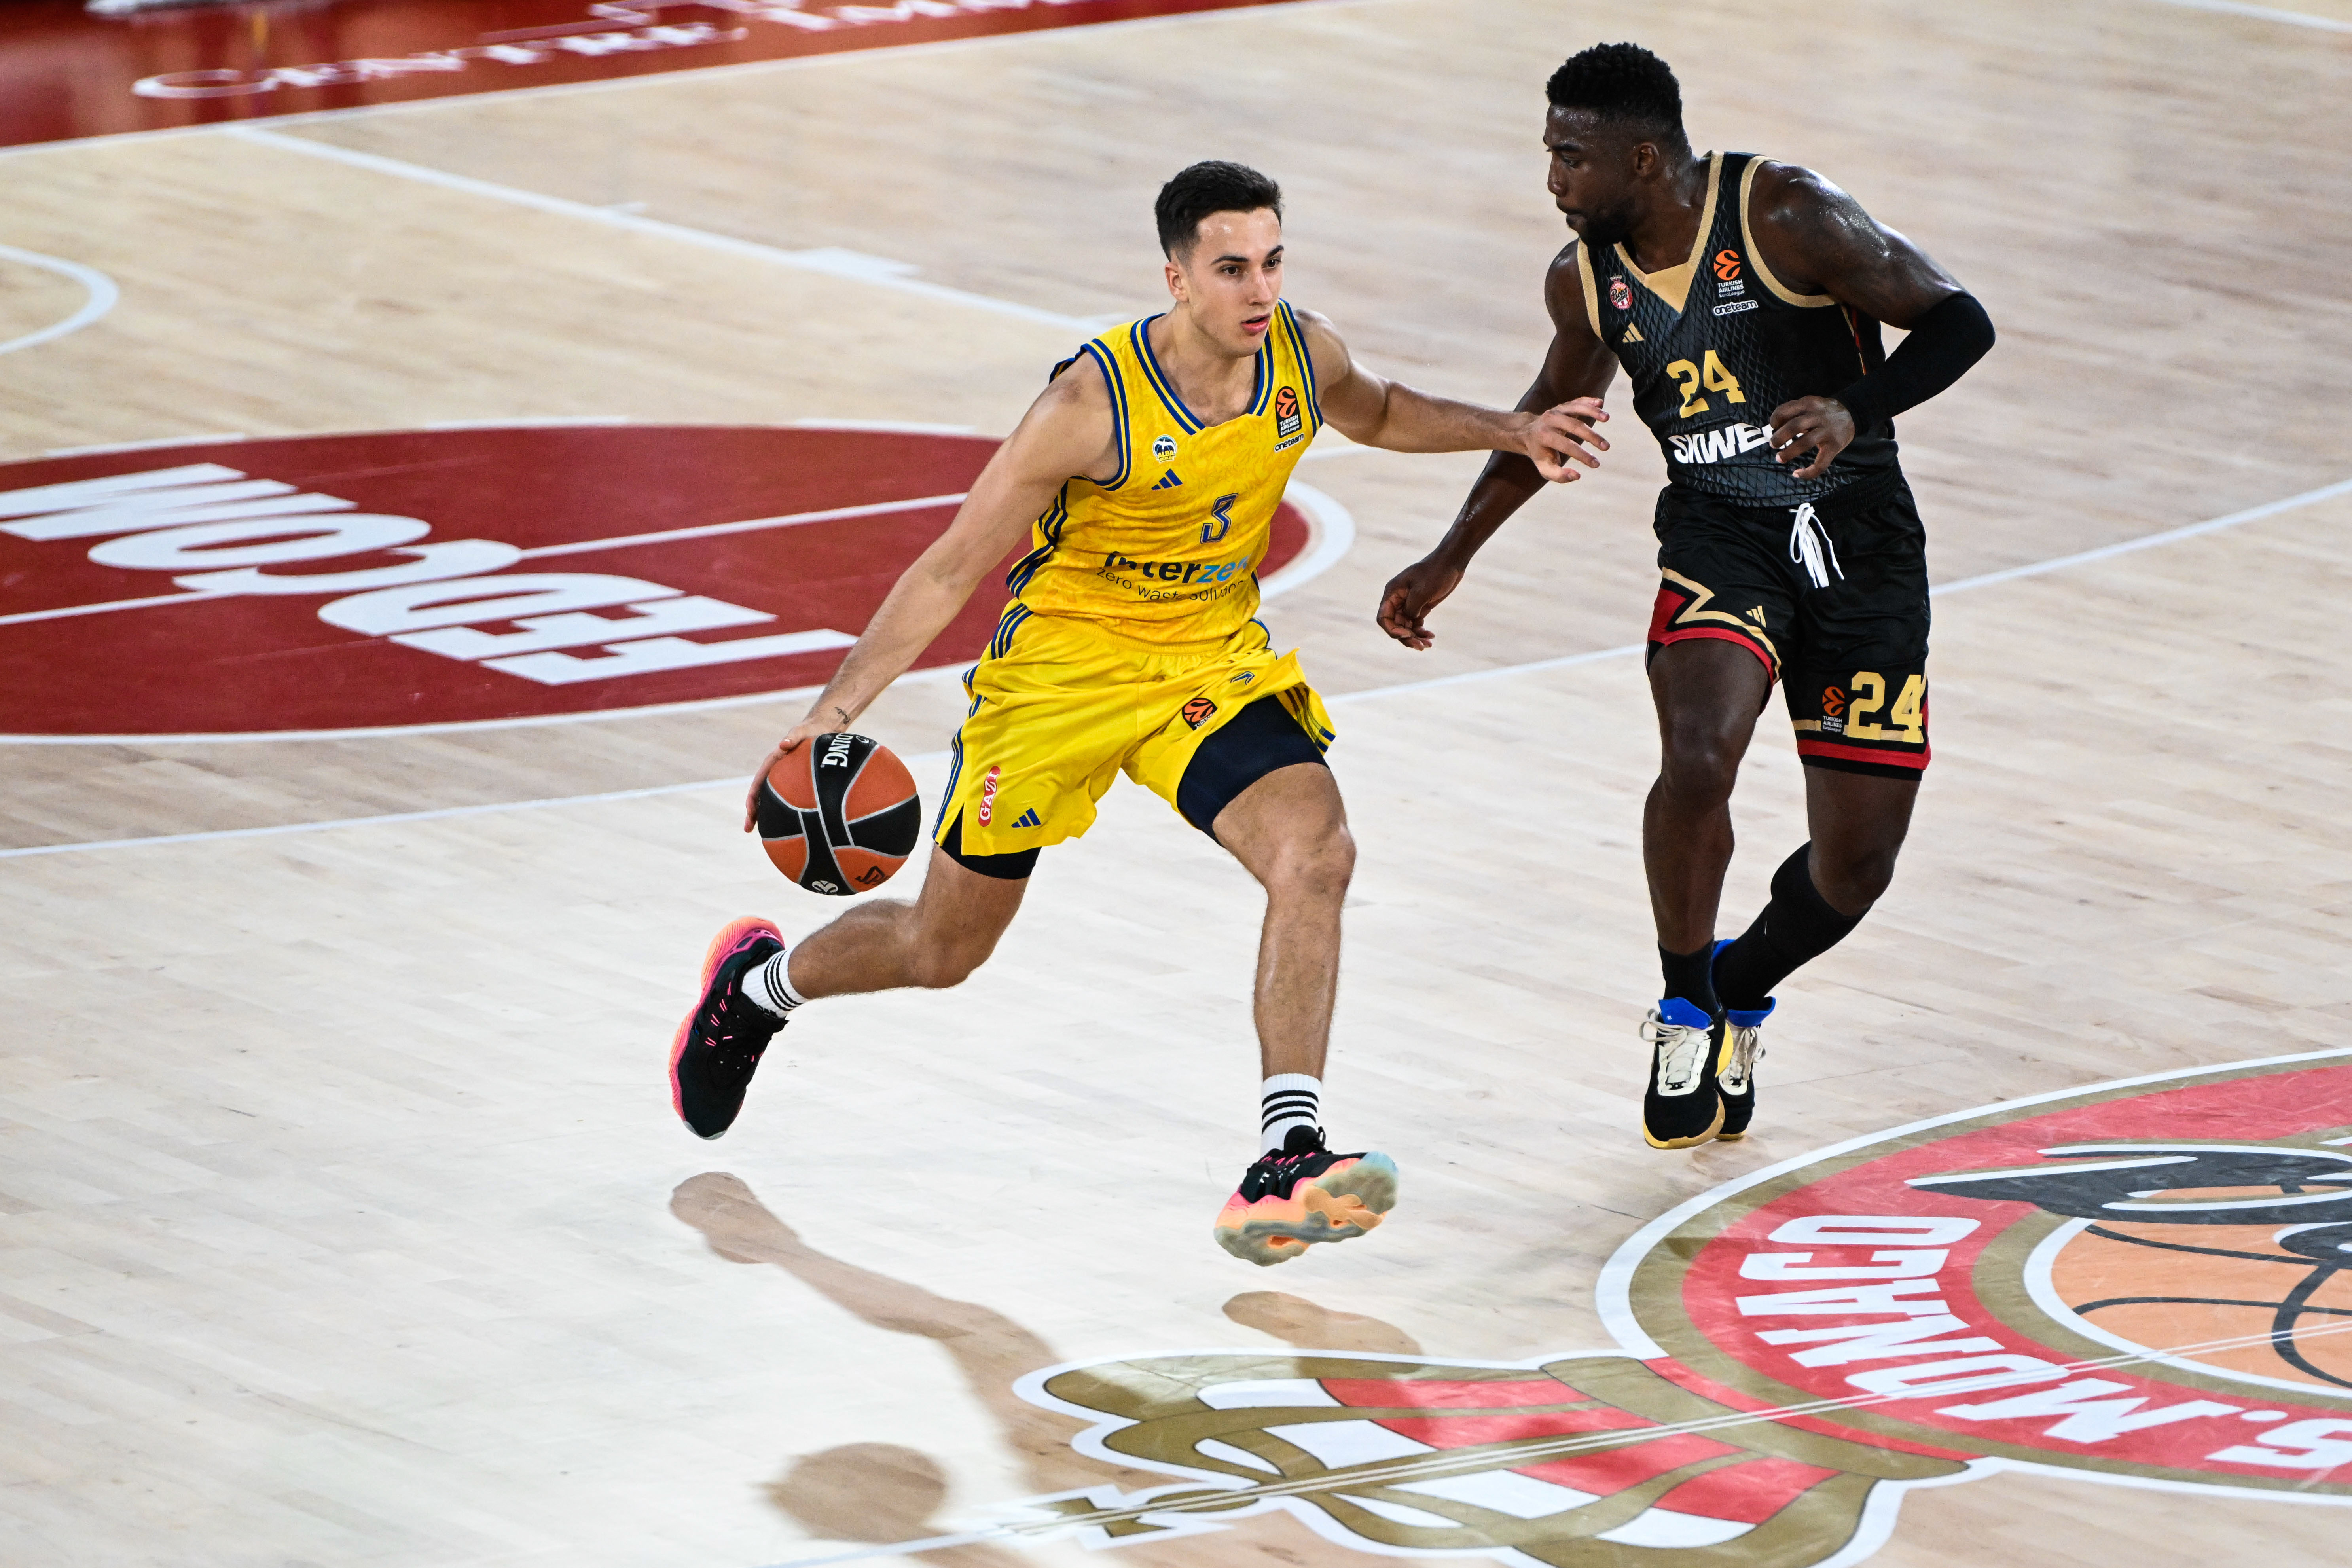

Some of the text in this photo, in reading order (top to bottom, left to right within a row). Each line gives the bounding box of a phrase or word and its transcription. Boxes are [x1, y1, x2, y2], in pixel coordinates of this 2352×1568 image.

[1717, 279, 1743, 288] TURKISH
[1719, 284, 1744, 293] AIRLINES
[1714, 301, 1757, 315] oneteam
[1667, 350, 1746, 418] 24
[1279, 414, 1298, 426] TURKISH
[1281, 419, 1299, 431] AIRLINES
[1275, 433, 1304, 451] oneteam
[1158, 450, 1175, 459] ALBA
[0, 462, 862, 685] FEDCOM
[1097, 567, 1132, 589] zero
[1847, 671, 1924, 744] 24
[822, 733, 854, 767] DING
[980, 771, 999, 820] GAZI
